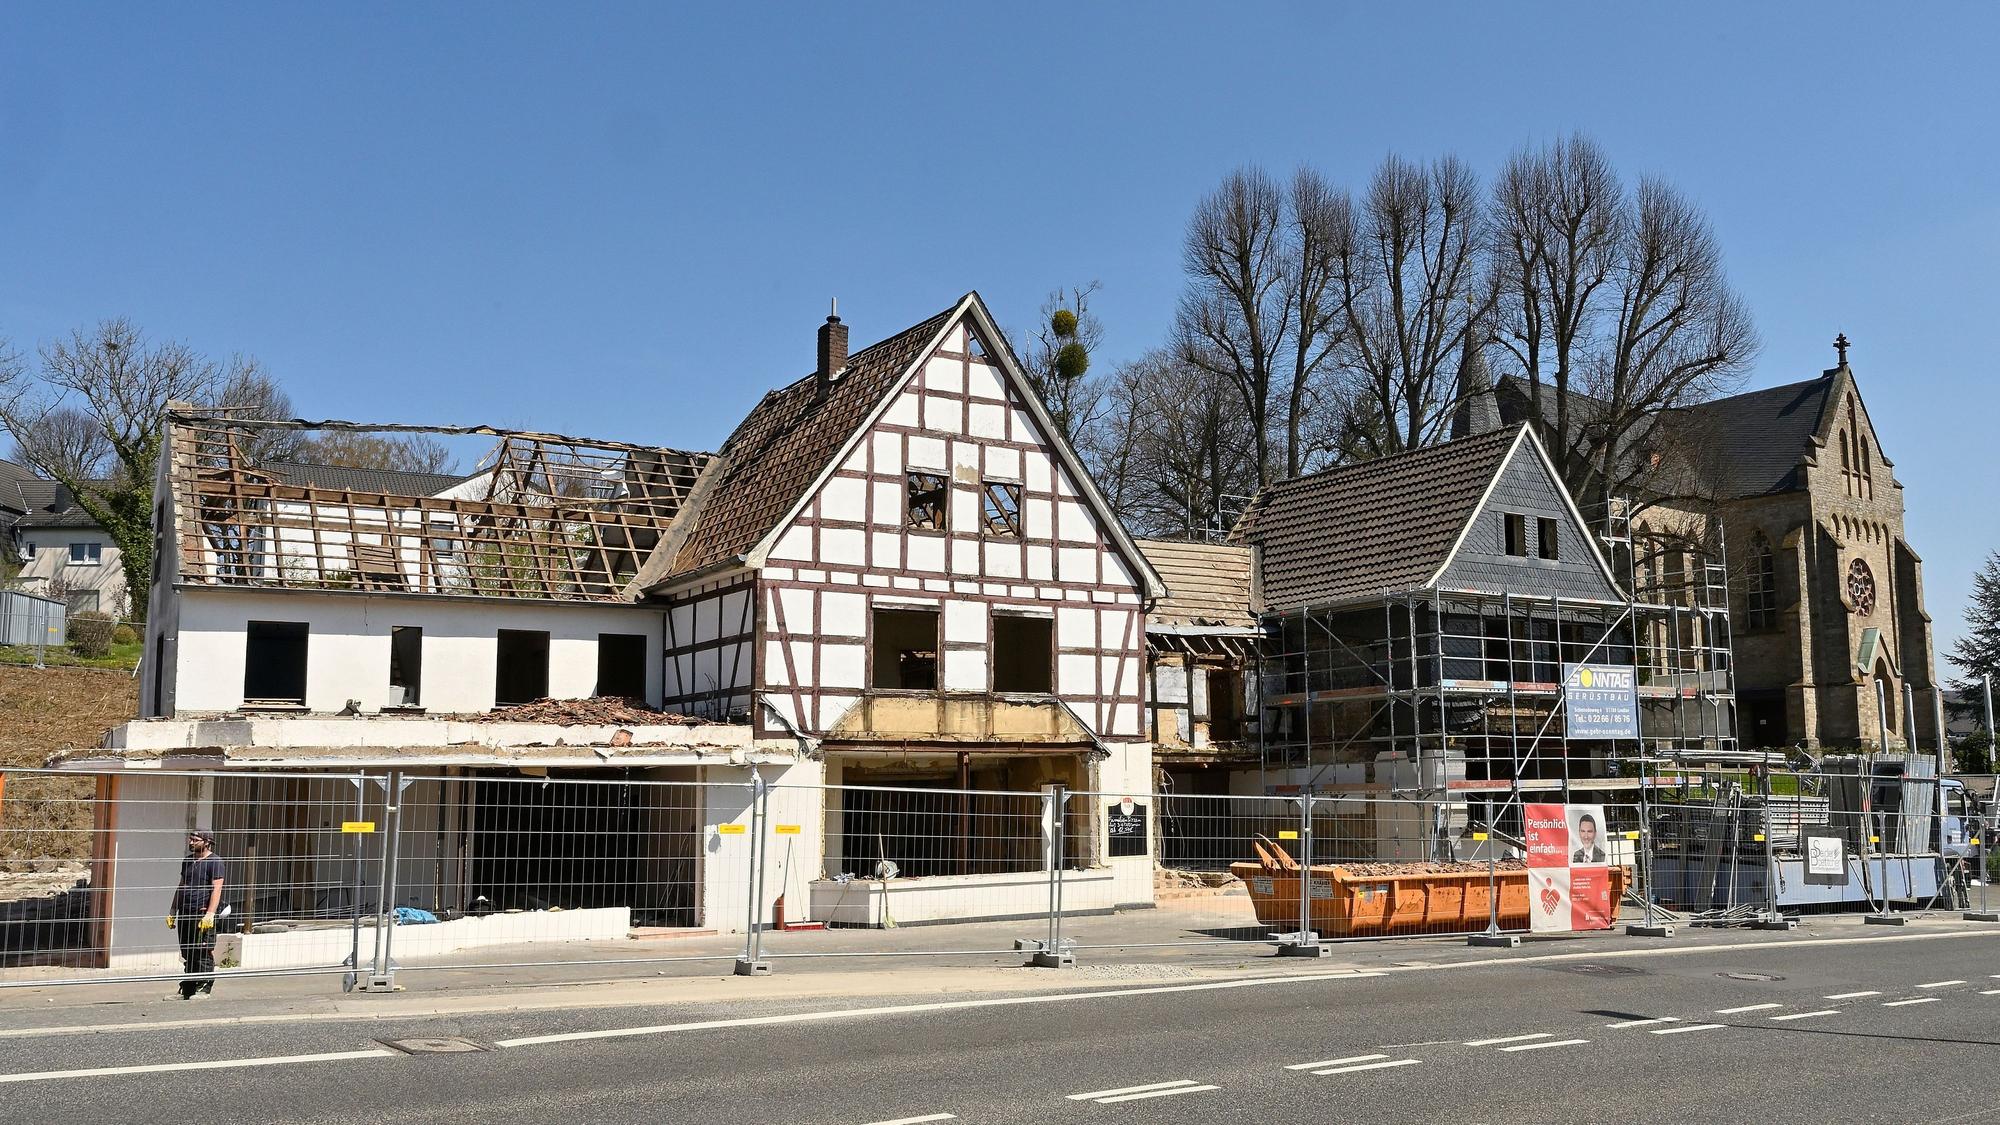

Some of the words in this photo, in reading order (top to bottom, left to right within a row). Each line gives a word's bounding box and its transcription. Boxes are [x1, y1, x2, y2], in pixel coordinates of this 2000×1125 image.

[1569, 667, 1630, 688] SONNTAG
[1567, 692, 1629, 701] GERÜSTBAU
[1528, 819, 1566, 829] Persönlich
[1528, 831, 1538, 841] ist
